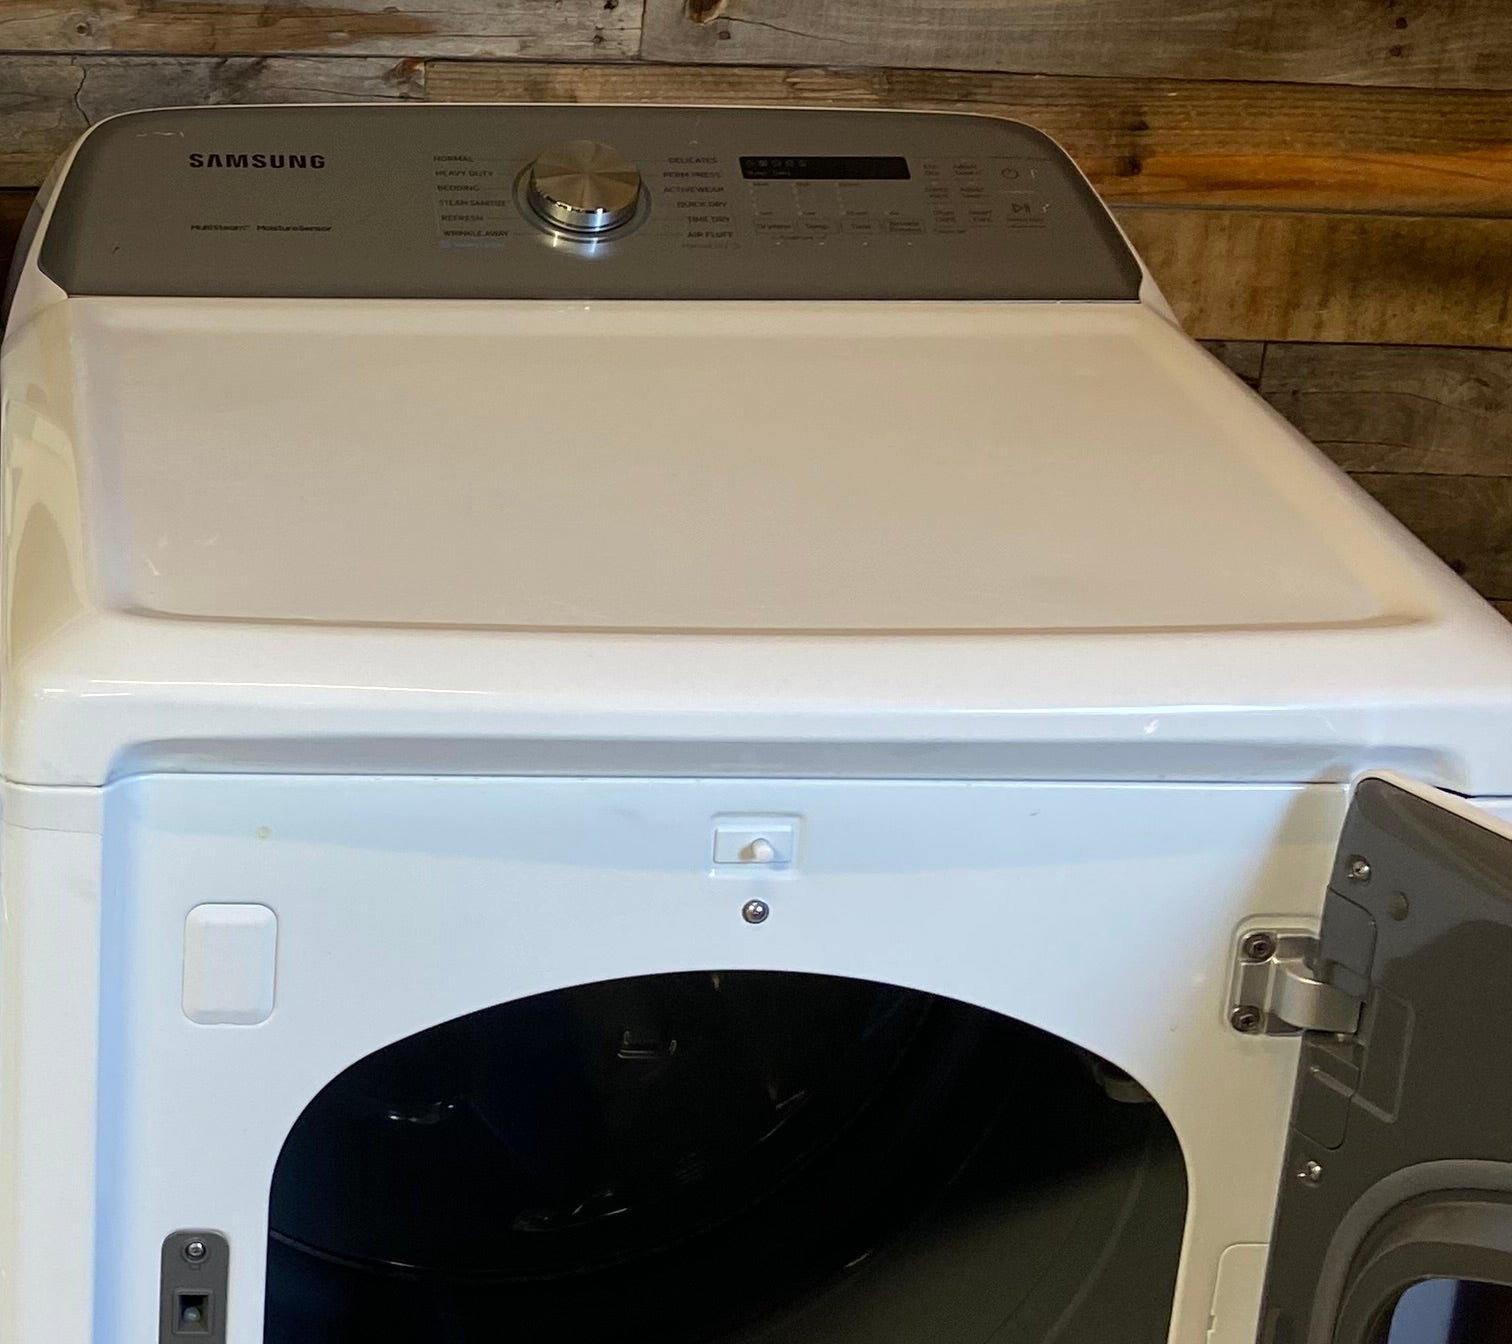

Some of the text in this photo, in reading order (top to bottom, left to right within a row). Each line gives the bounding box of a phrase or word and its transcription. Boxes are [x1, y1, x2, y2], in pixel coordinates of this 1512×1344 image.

[189, 153, 326, 169] SAMSUNG
[433, 155, 474, 163] NORMAL
[668, 156, 718, 164] DELICATES
[436, 184, 481, 192] BEDDING
